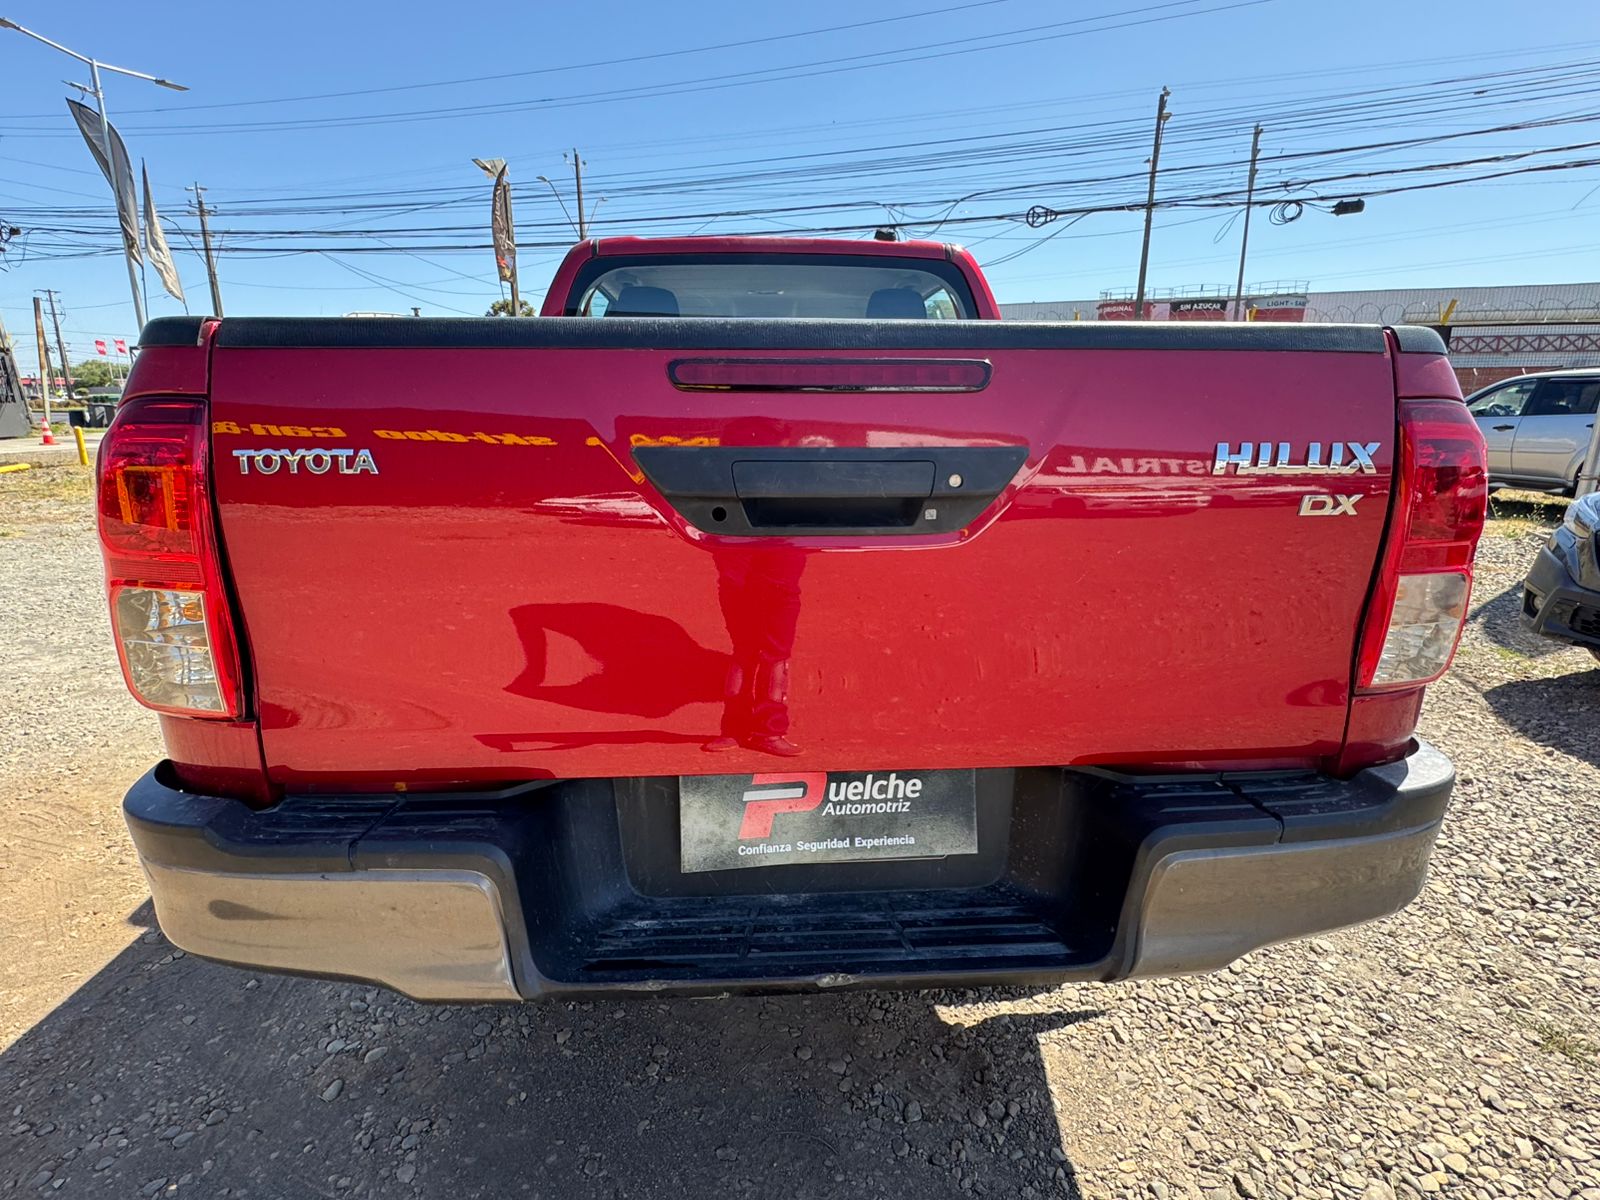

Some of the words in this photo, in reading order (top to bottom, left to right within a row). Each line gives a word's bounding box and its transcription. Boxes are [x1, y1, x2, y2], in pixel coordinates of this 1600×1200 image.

[232, 448, 379, 475] TOYOTA
[1212, 442, 1381, 476] HILUX
[1298, 494, 1364, 516] DX
[822, 800, 911, 817] Automotriz
[738, 844, 792, 856] Confianza
[796, 837, 850, 854] Seguridad
[854, 834, 915, 850] Experiencia
